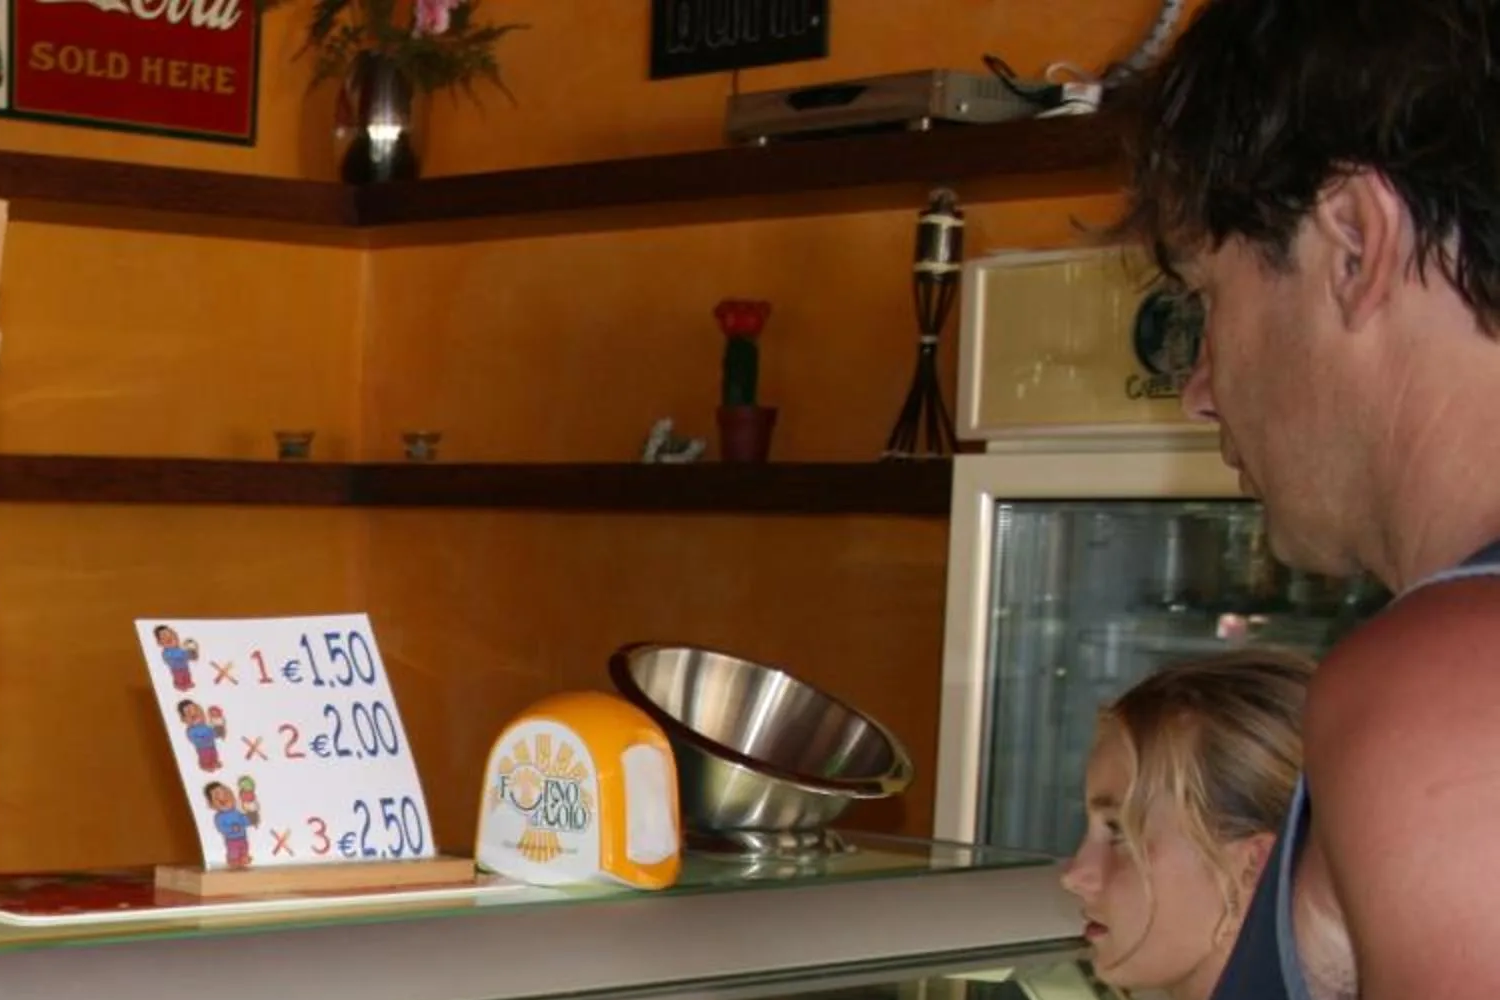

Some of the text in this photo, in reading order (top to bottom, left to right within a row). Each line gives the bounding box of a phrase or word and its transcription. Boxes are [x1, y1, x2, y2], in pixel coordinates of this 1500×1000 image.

[28, 41, 237, 94] SOLD HERE
[251, 650, 273, 684] 1
[277, 724, 306, 759] 2
[306, 817, 331, 854] 3
